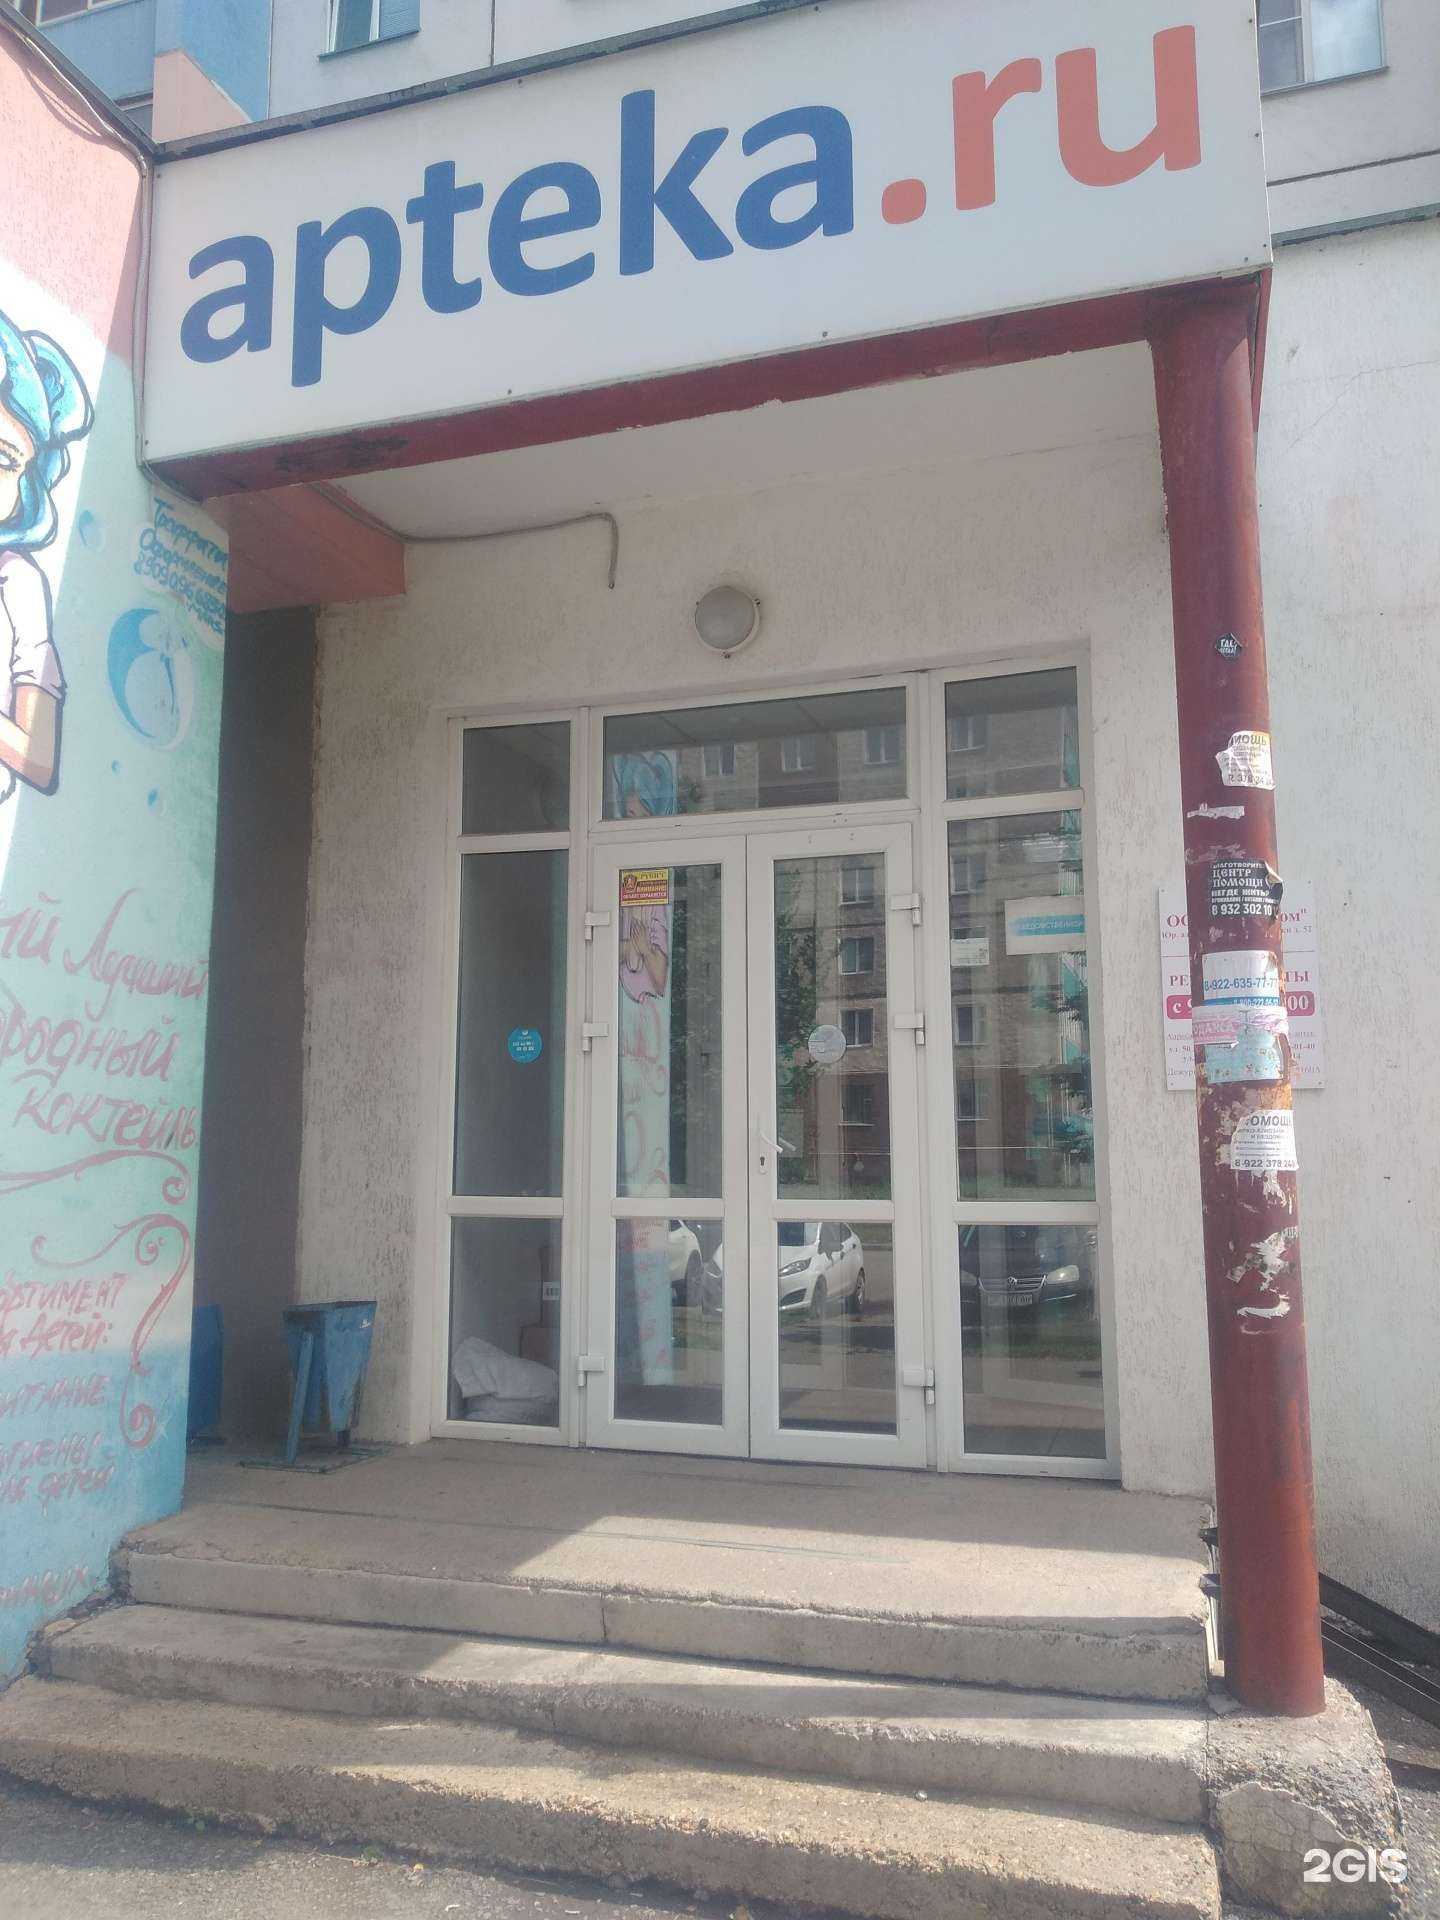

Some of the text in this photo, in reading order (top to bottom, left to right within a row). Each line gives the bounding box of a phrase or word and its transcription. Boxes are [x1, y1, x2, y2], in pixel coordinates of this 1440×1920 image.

[180, 24, 1202, 388] apteka.ru
[1213, 868, 1251, 878] ЦЕНТР
[1212, 878, 1264, 888] ПОМОЩИ
[1220, 903, 1240, 915] 932
[1243, 903, 1262, 914] 302
